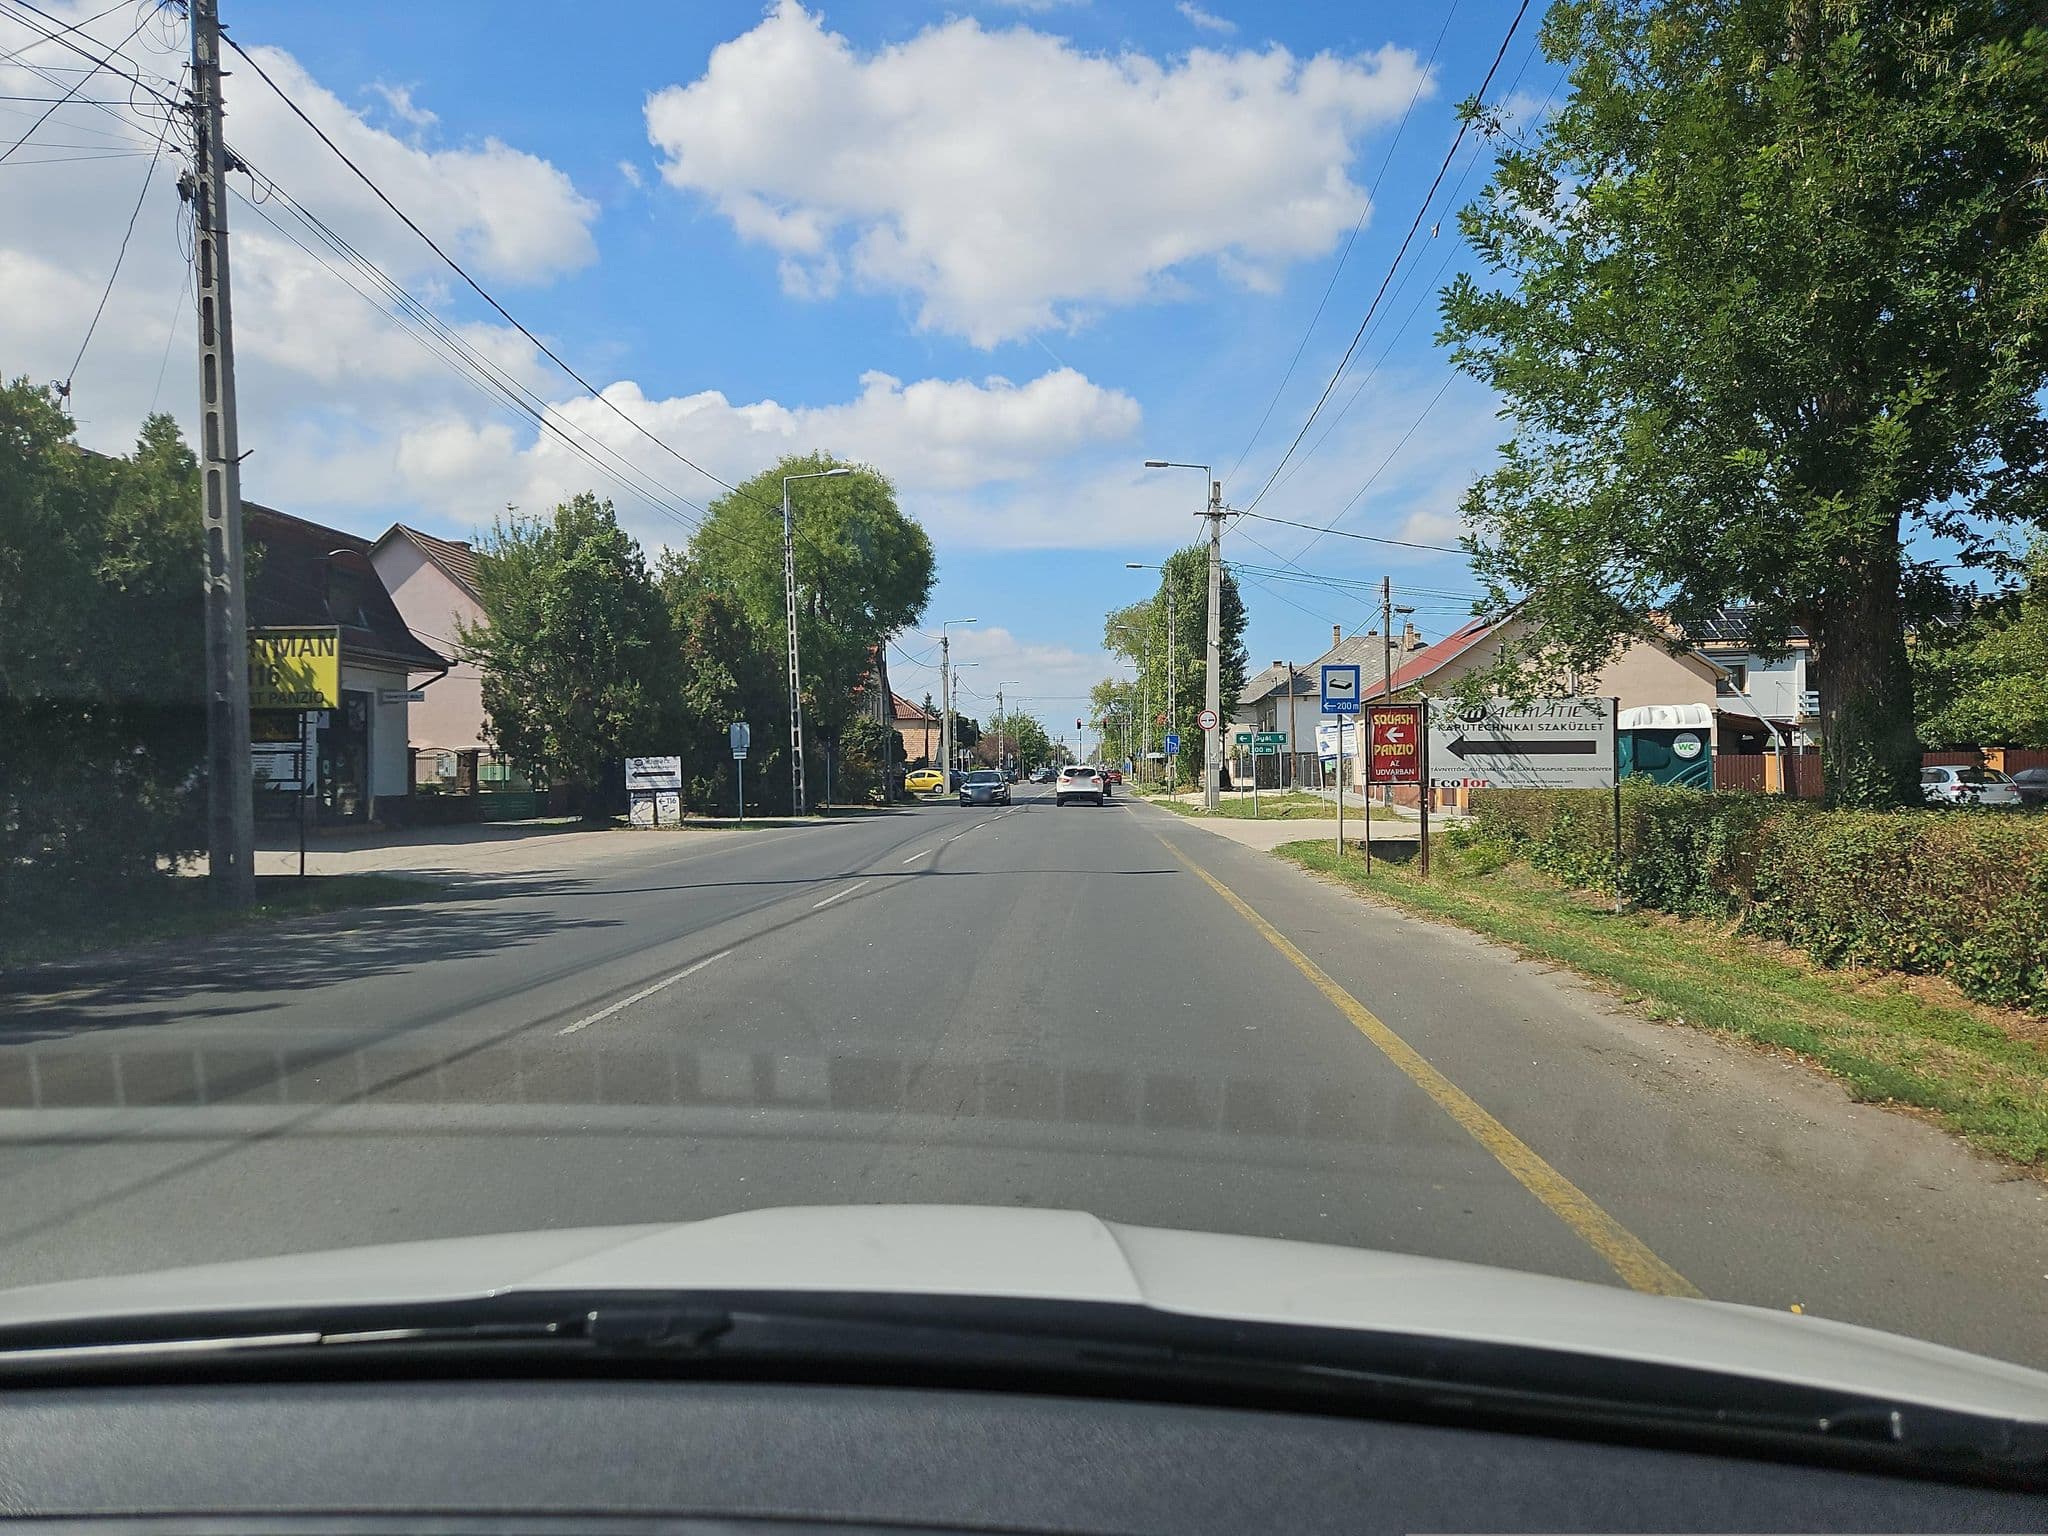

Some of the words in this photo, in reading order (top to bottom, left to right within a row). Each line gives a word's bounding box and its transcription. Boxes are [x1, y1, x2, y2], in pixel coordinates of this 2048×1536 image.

[1336, 702, 1352, 710] 200
[1373, 714, 1414, 727] SQUASH
[1438, 723, 1534, 732] KAPUTECHNIKAI
[1537, 722, 1605, 732] SZAKÜZLET
[1375, 768, 1415, 776] UDVARBAN
[1430, 777, 1489, 788] EcoTor
